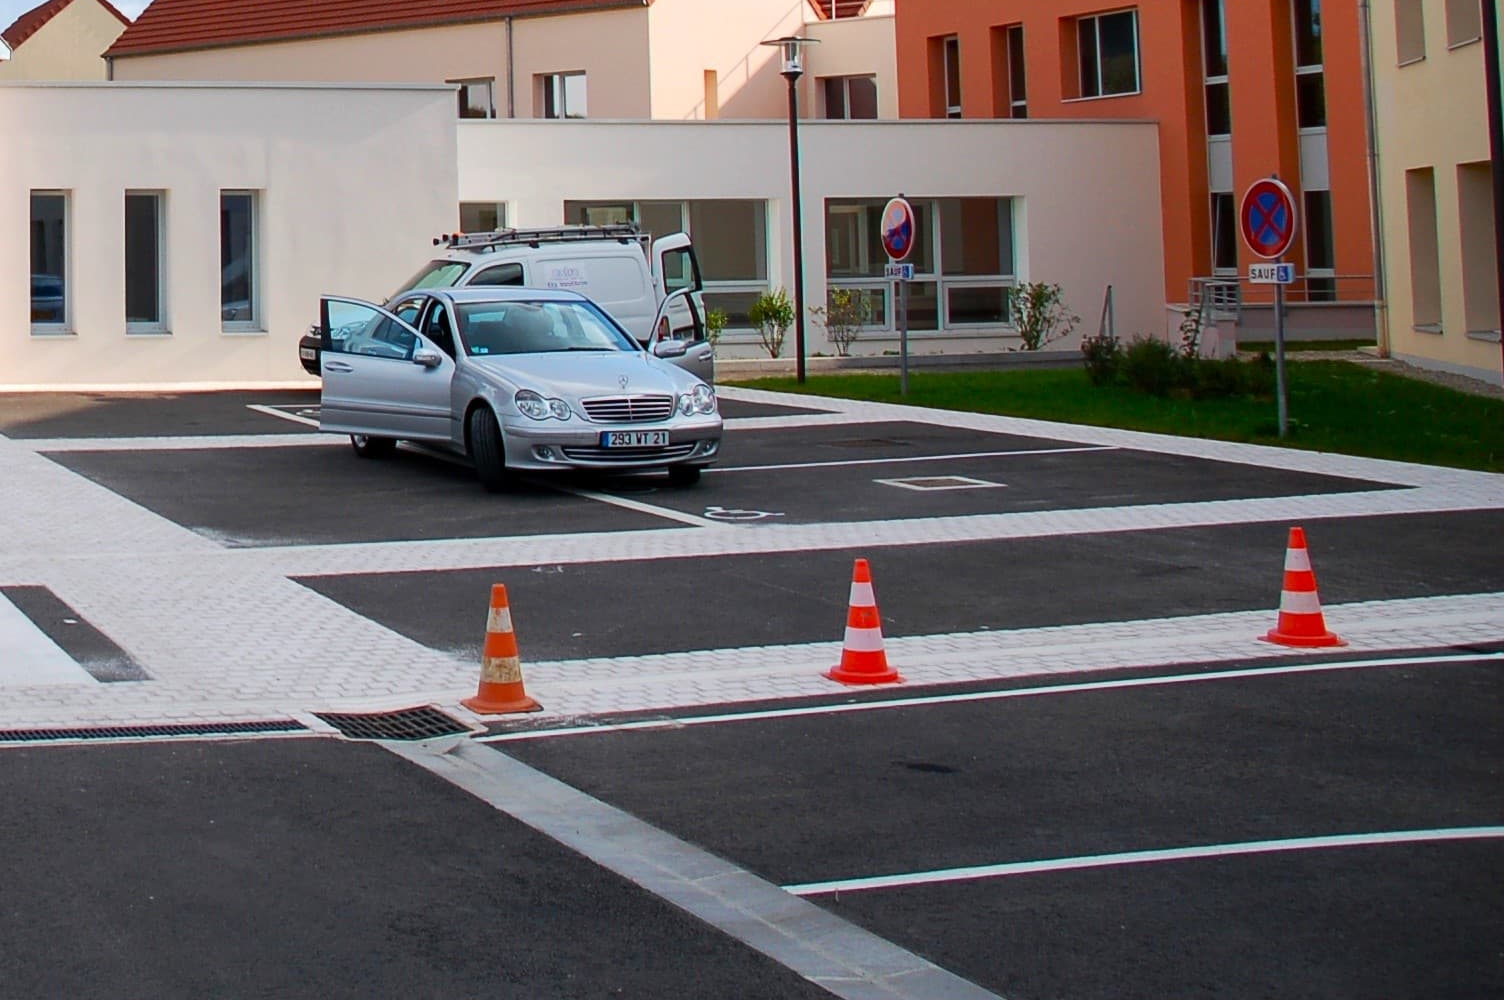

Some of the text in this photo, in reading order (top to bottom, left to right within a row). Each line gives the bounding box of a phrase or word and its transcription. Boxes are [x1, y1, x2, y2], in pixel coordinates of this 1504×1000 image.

[1250, 268, 1275, 279] SAUF
[611, 432, 632, 445] 293
[654, 432, 666, 444] 21
